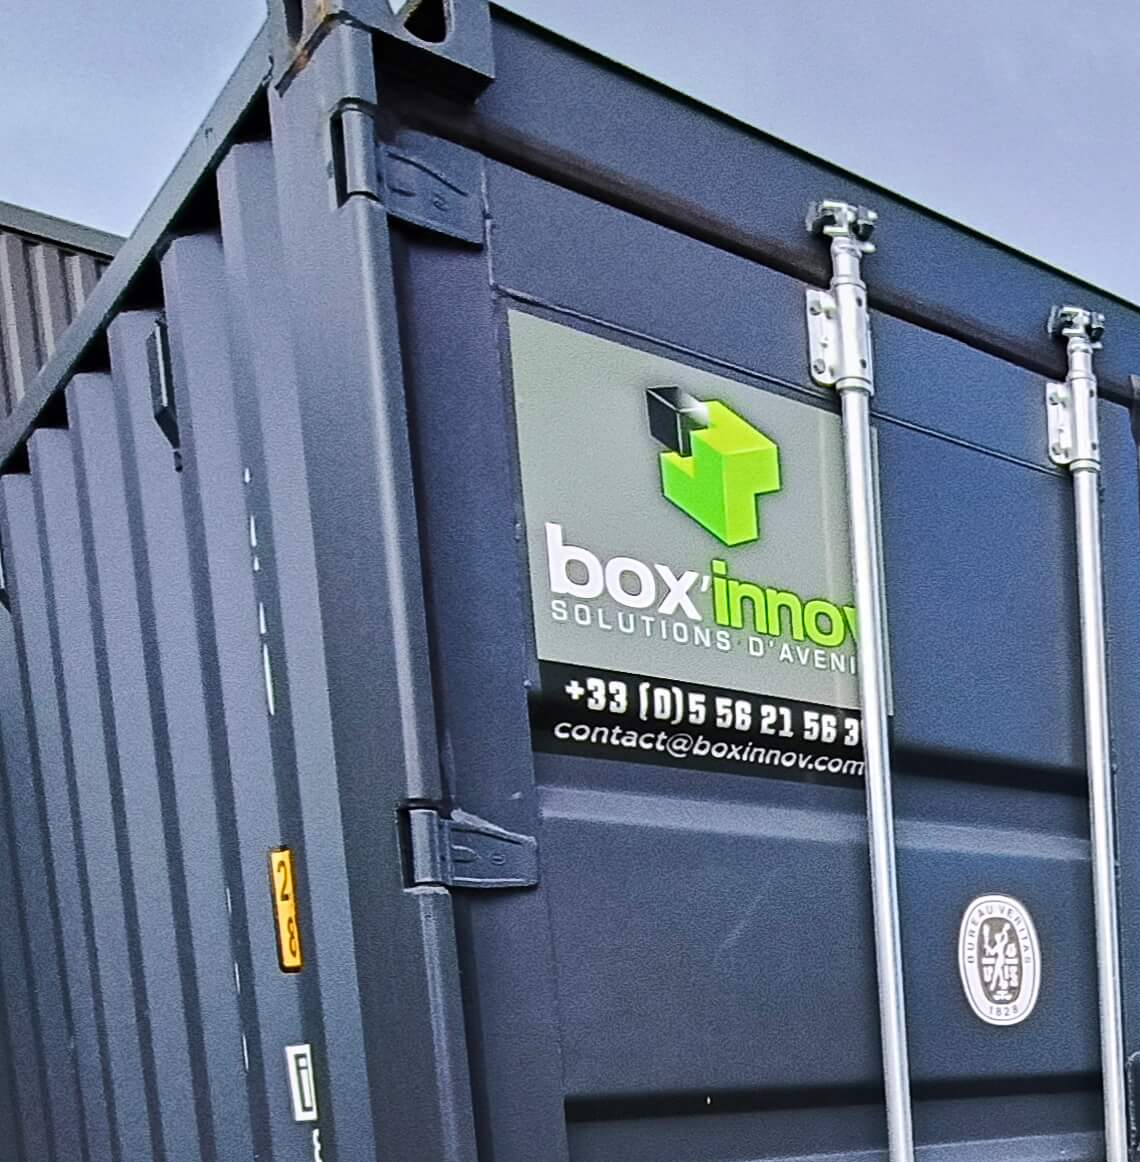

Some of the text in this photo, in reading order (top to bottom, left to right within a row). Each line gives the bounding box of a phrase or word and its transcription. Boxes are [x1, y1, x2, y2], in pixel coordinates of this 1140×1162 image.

[551, 600, 857, 675] SOLUTIONS D'AVENI
[565, 678, 863, 747] +33 (0)5 56 21 56 3
[554, 721, 865, 776] contact@boxinnov.com
